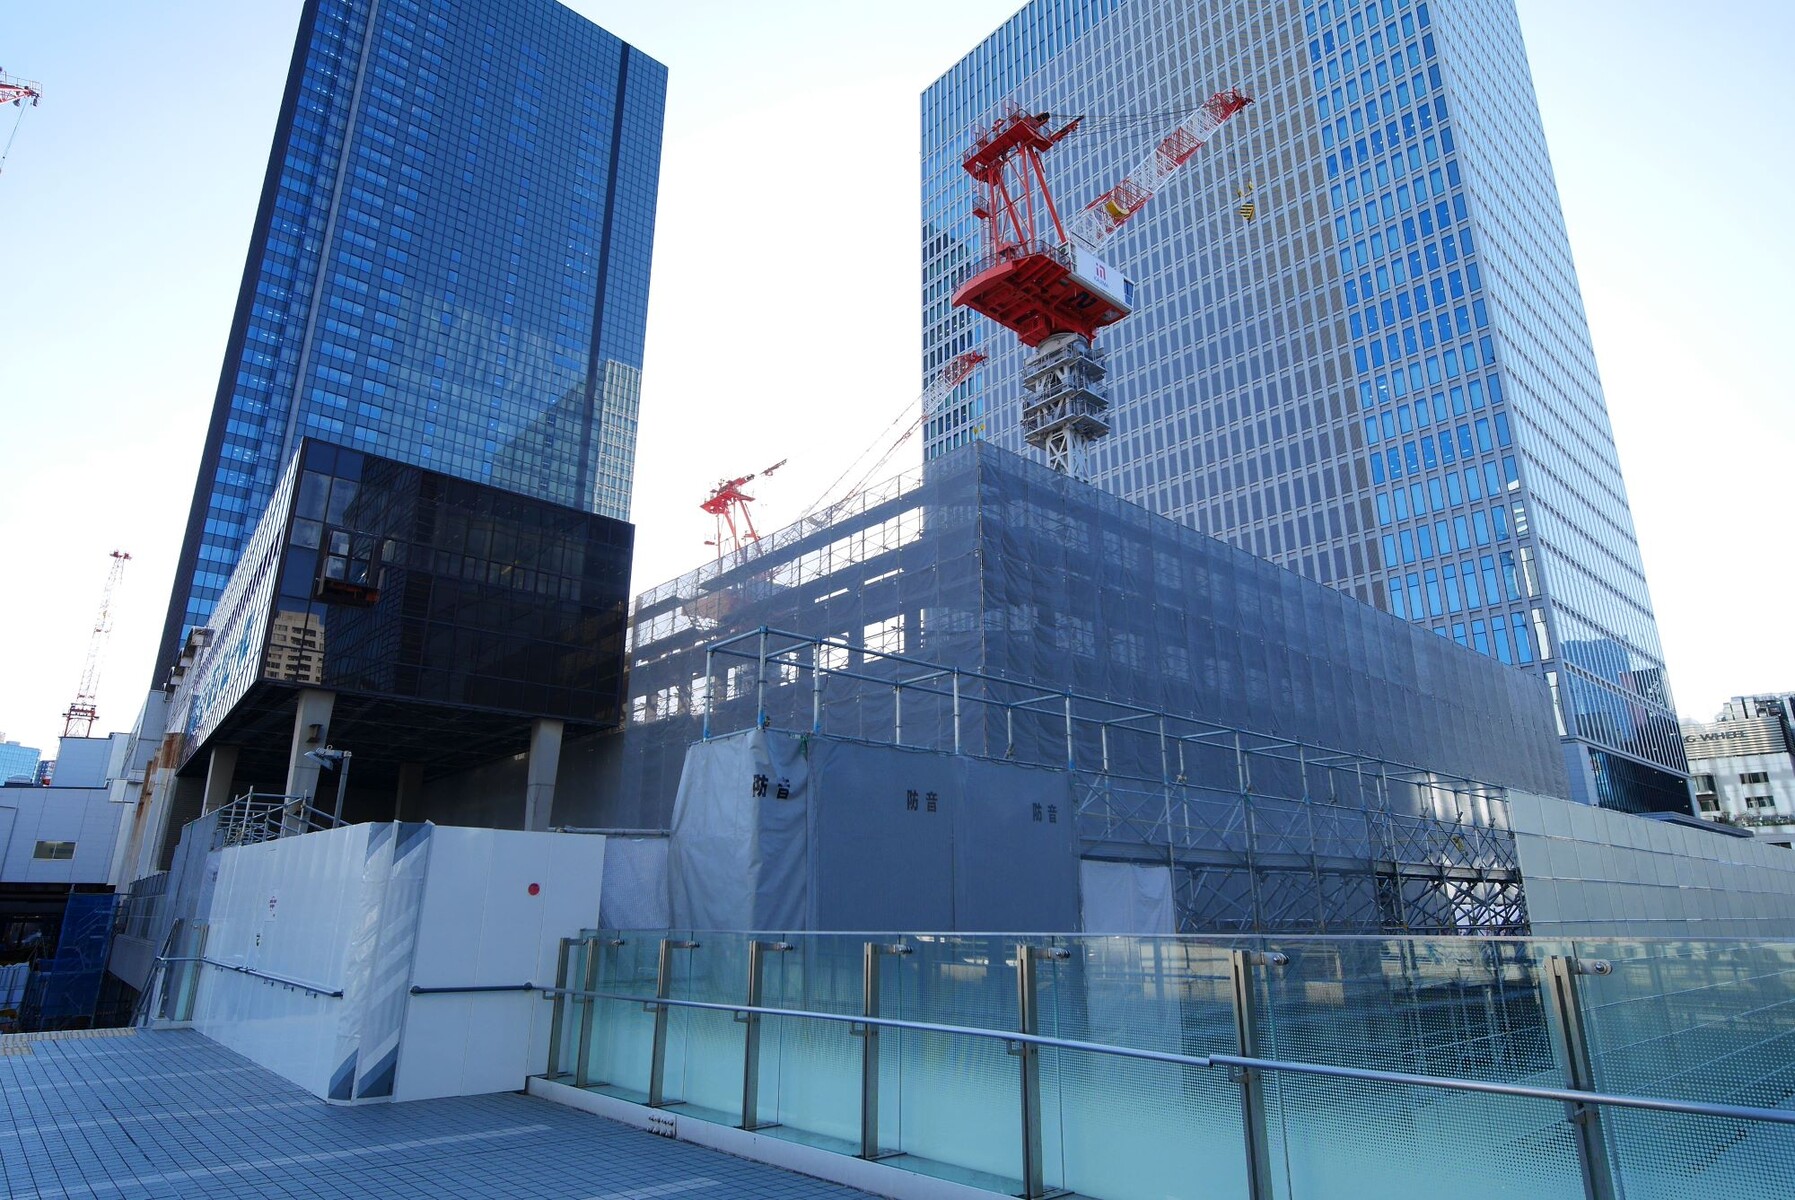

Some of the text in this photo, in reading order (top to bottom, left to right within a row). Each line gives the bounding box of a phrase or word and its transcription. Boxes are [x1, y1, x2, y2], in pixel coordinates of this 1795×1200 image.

[1682, 734, 1697, 744] G
[752, 774, 790, 800] 防音
[907, 790, 938, 812] 防音
[1032, 802, 1057, 824] 防音
